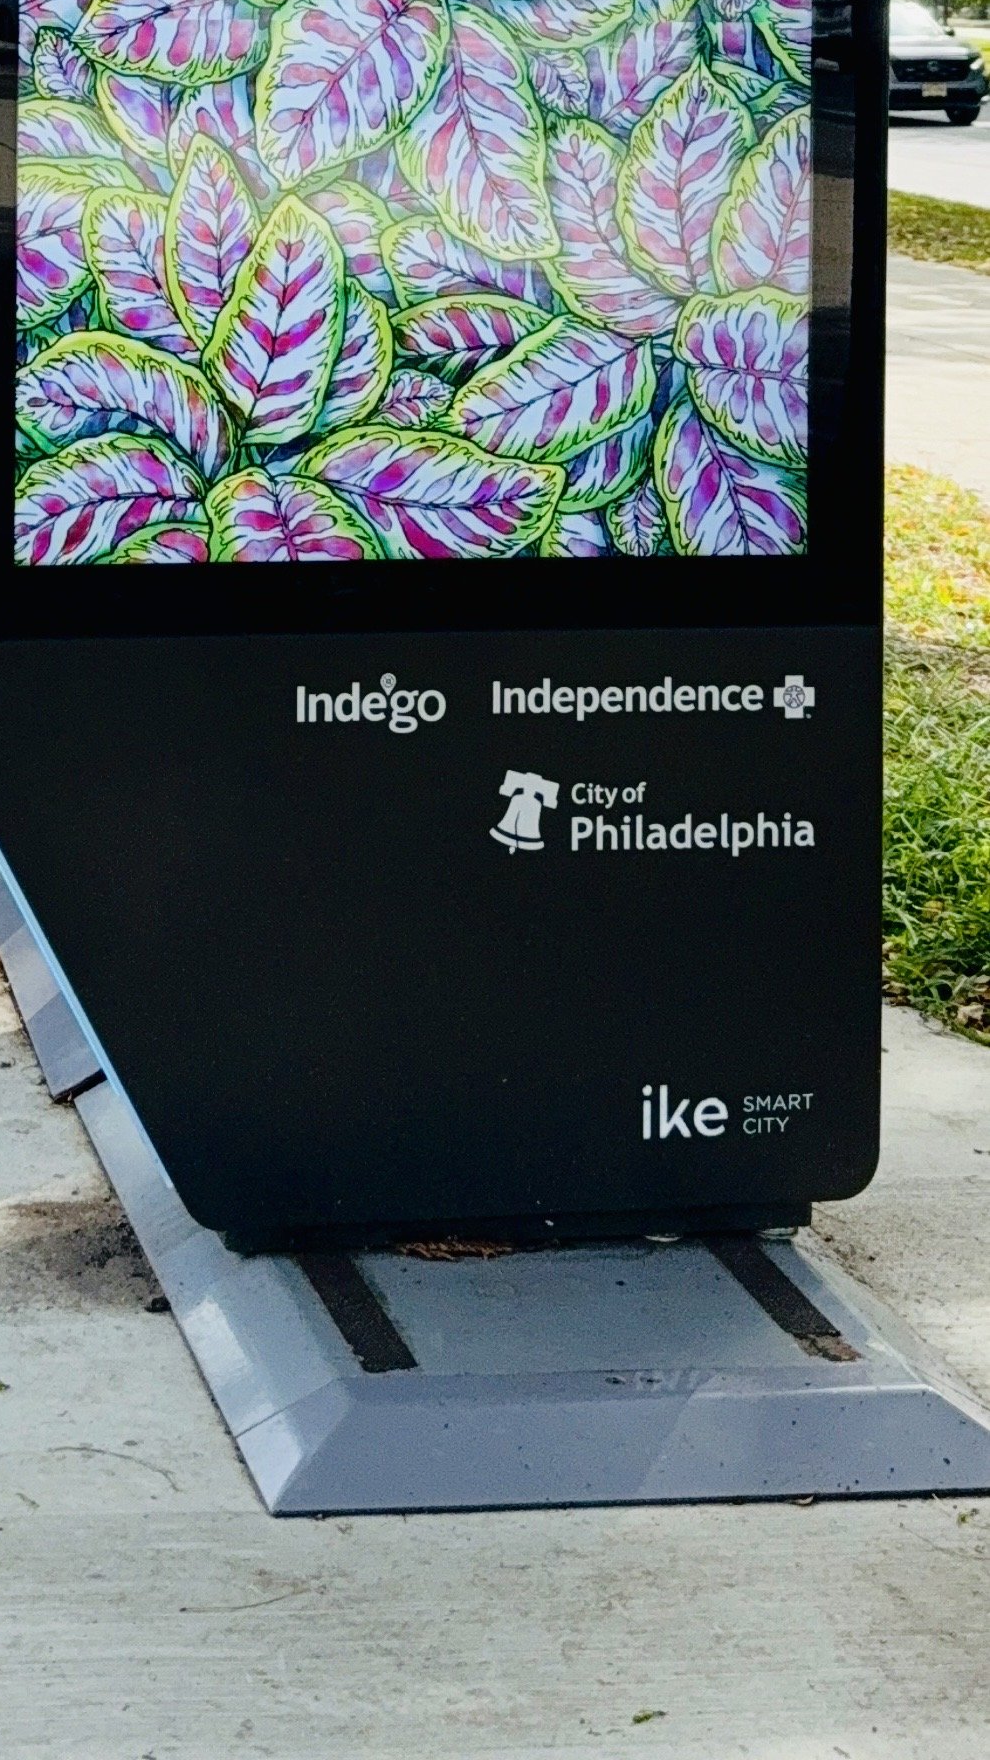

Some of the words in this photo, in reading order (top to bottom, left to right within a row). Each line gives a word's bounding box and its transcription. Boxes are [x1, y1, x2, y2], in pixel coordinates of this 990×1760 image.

[296, 674, 447, 734] Indego
[492, 676, 764, 722] Independence
[571, 782, 619, 809] City
[621, 781, 647, 804] of
[571, 811, 816, 857] Philadelphia
[641, 1084, 729, 1140] ike
[742, 1116, 789, 1135] CITY
[743, 1092, 814, 1113] SMART
